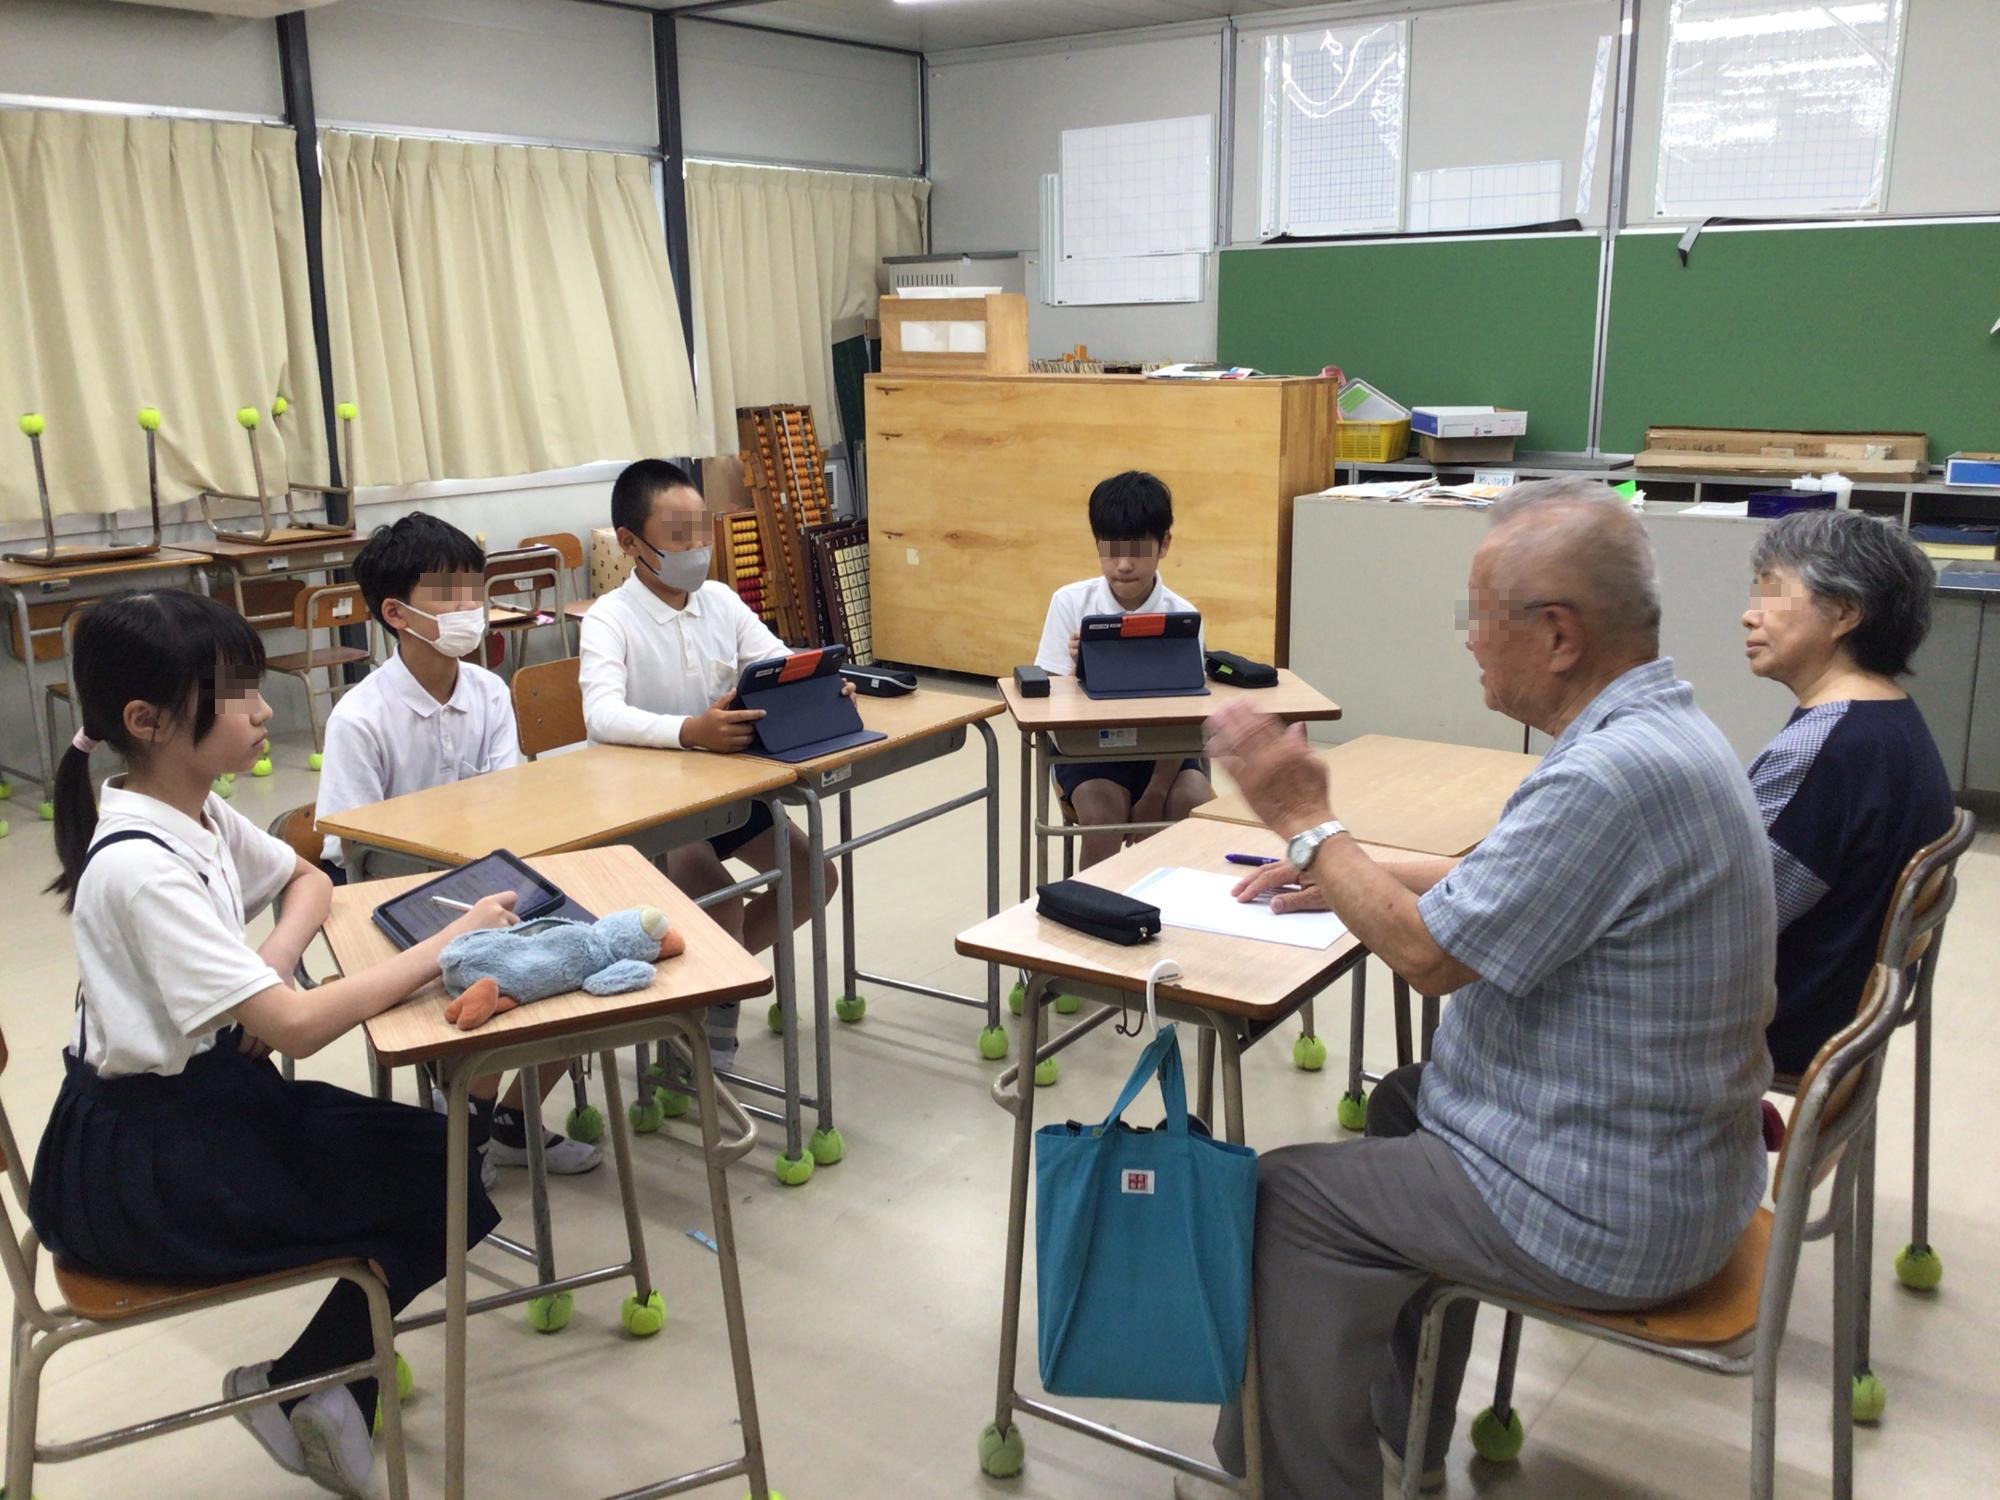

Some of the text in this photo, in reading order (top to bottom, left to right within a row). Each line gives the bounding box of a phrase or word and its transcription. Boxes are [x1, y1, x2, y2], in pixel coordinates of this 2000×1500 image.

[843, 537, 848, 545] 2
[852, 534, 857, 543] 3
[832, 568, 836, 576] 2
[834, 581, 839, 590] 3
[839, 607, 844, 616] 5
